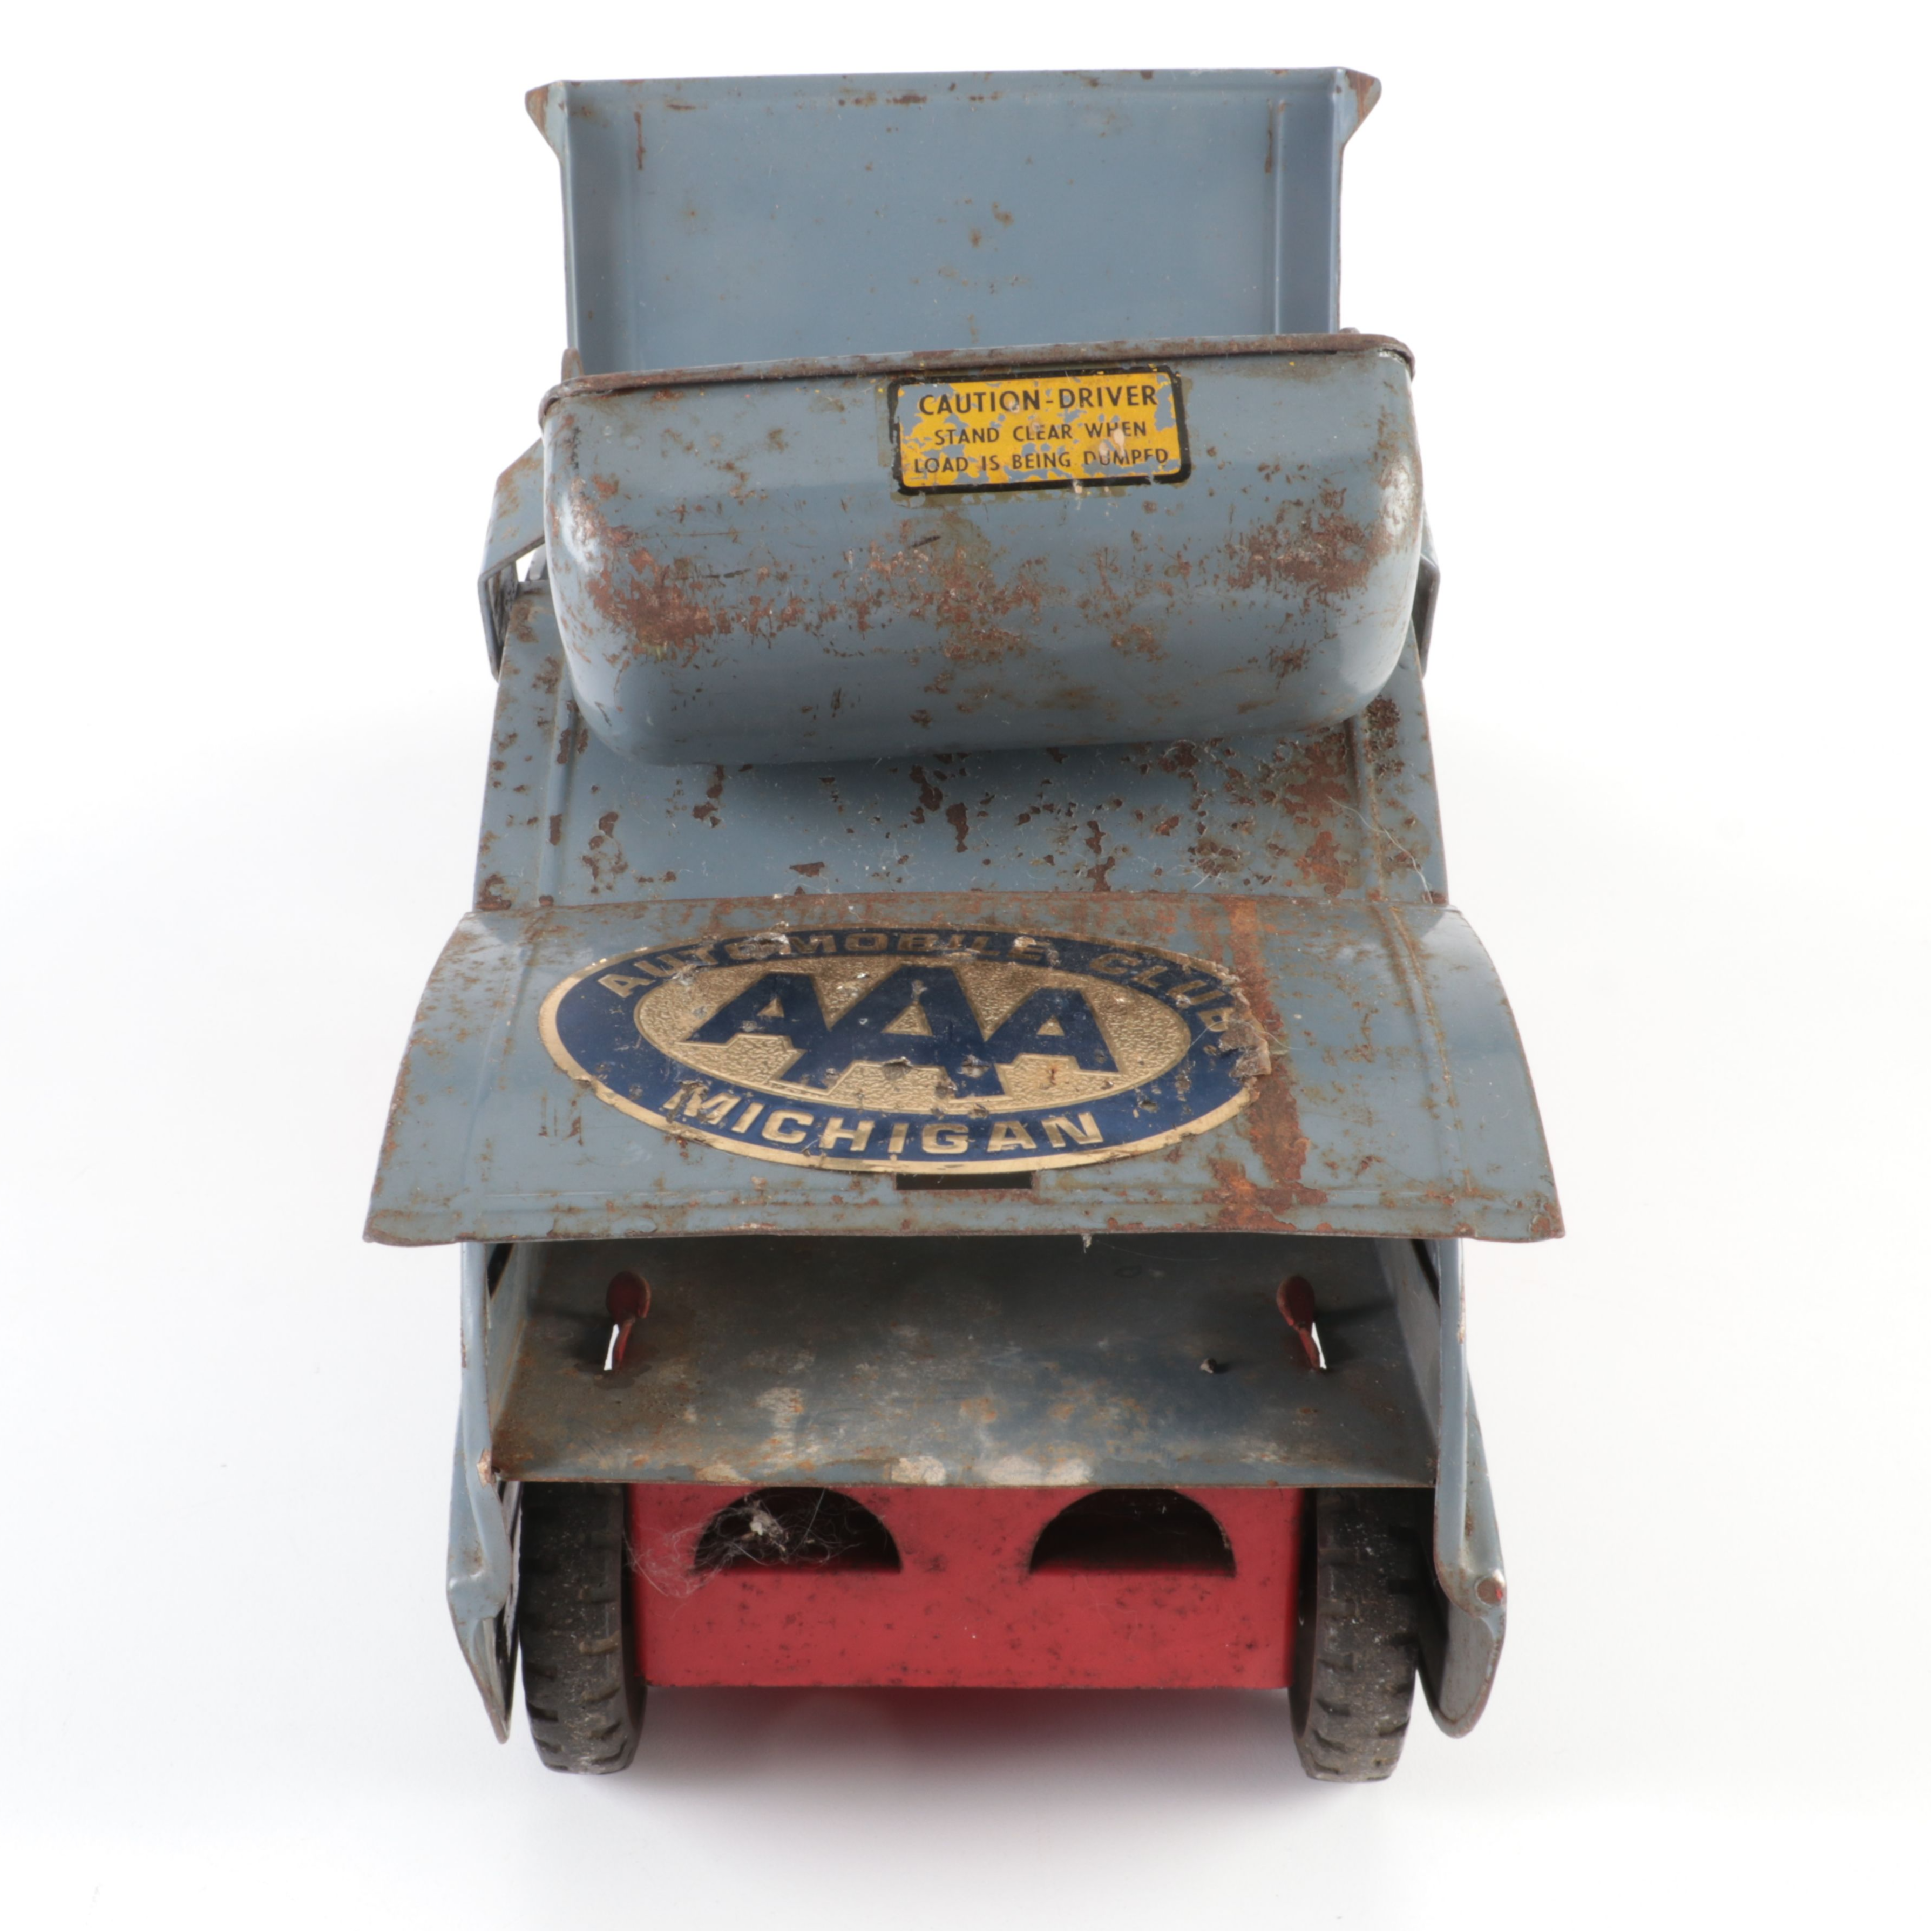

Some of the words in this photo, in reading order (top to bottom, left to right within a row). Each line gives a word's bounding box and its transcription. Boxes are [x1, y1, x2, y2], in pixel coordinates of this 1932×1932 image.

[919, 385, 1157, 415] CAUTION-DRIVER
[935, 428, 1000, 445] STAND
[1013, 424, 1073, 441] CLEAR
[1085, 422, 1147, 438] WHEN
[915, 457, 970, 473] LOAD
[982, 456, 1000, 470] IS
[1012, 452, 1071, 470] BEING
[1084, 448, 1168, 466] DUMPED
[598, 932, 1050, 998] AUTOMOBILE
[680, 960, 1122, 1100] AAA
[663, 1082, 1103, 1154] MICHIGAN
